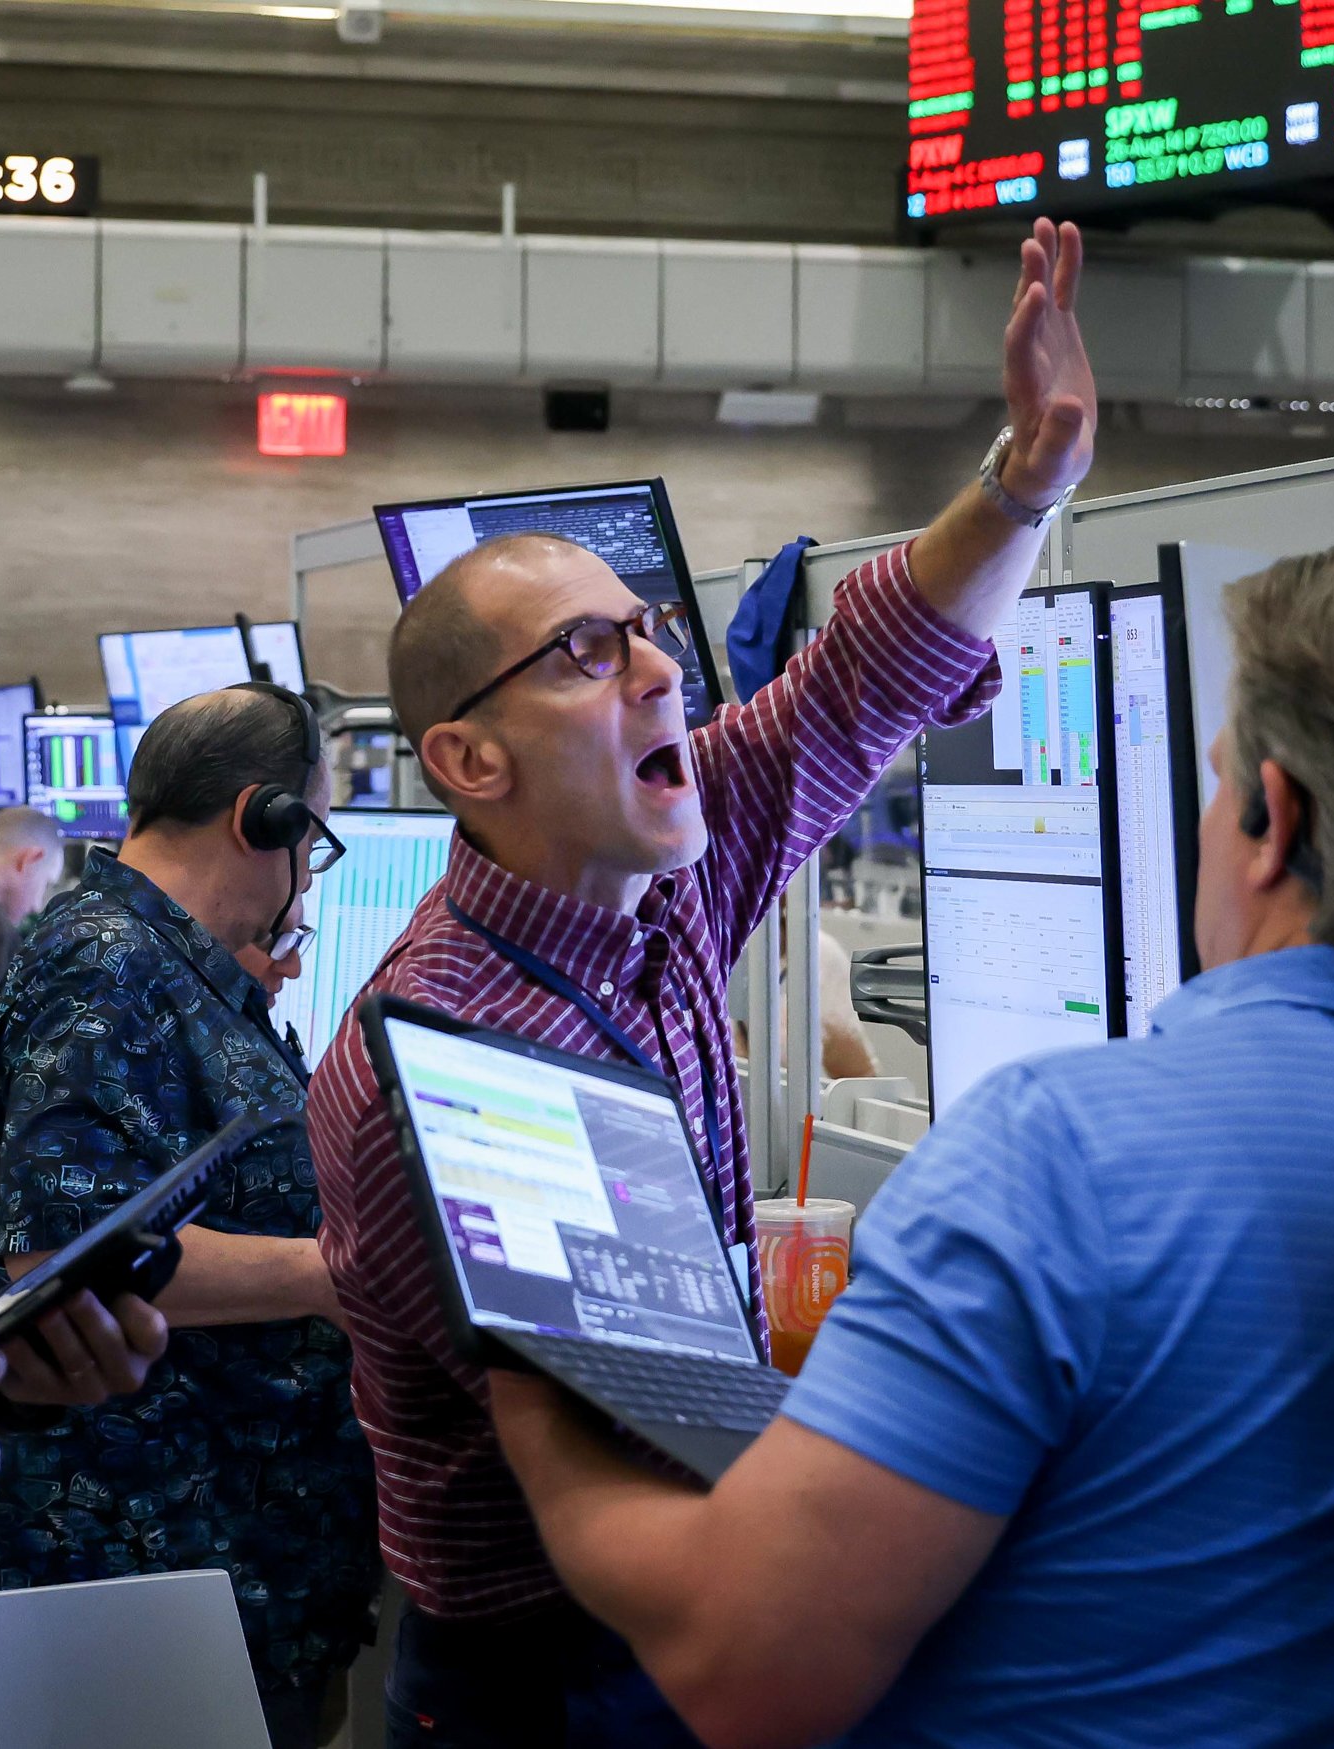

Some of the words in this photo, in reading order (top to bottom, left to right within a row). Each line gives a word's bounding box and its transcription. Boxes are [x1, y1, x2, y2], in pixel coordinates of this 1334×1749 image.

[1105, 97, 1178, 139] SPXW
[1224, 141, 1269, 170] WCB
[995, 176, 1038, 204] WCB
[269, 394, 336, 446] EXIT
[1127, 628, 1138, 641] 853
